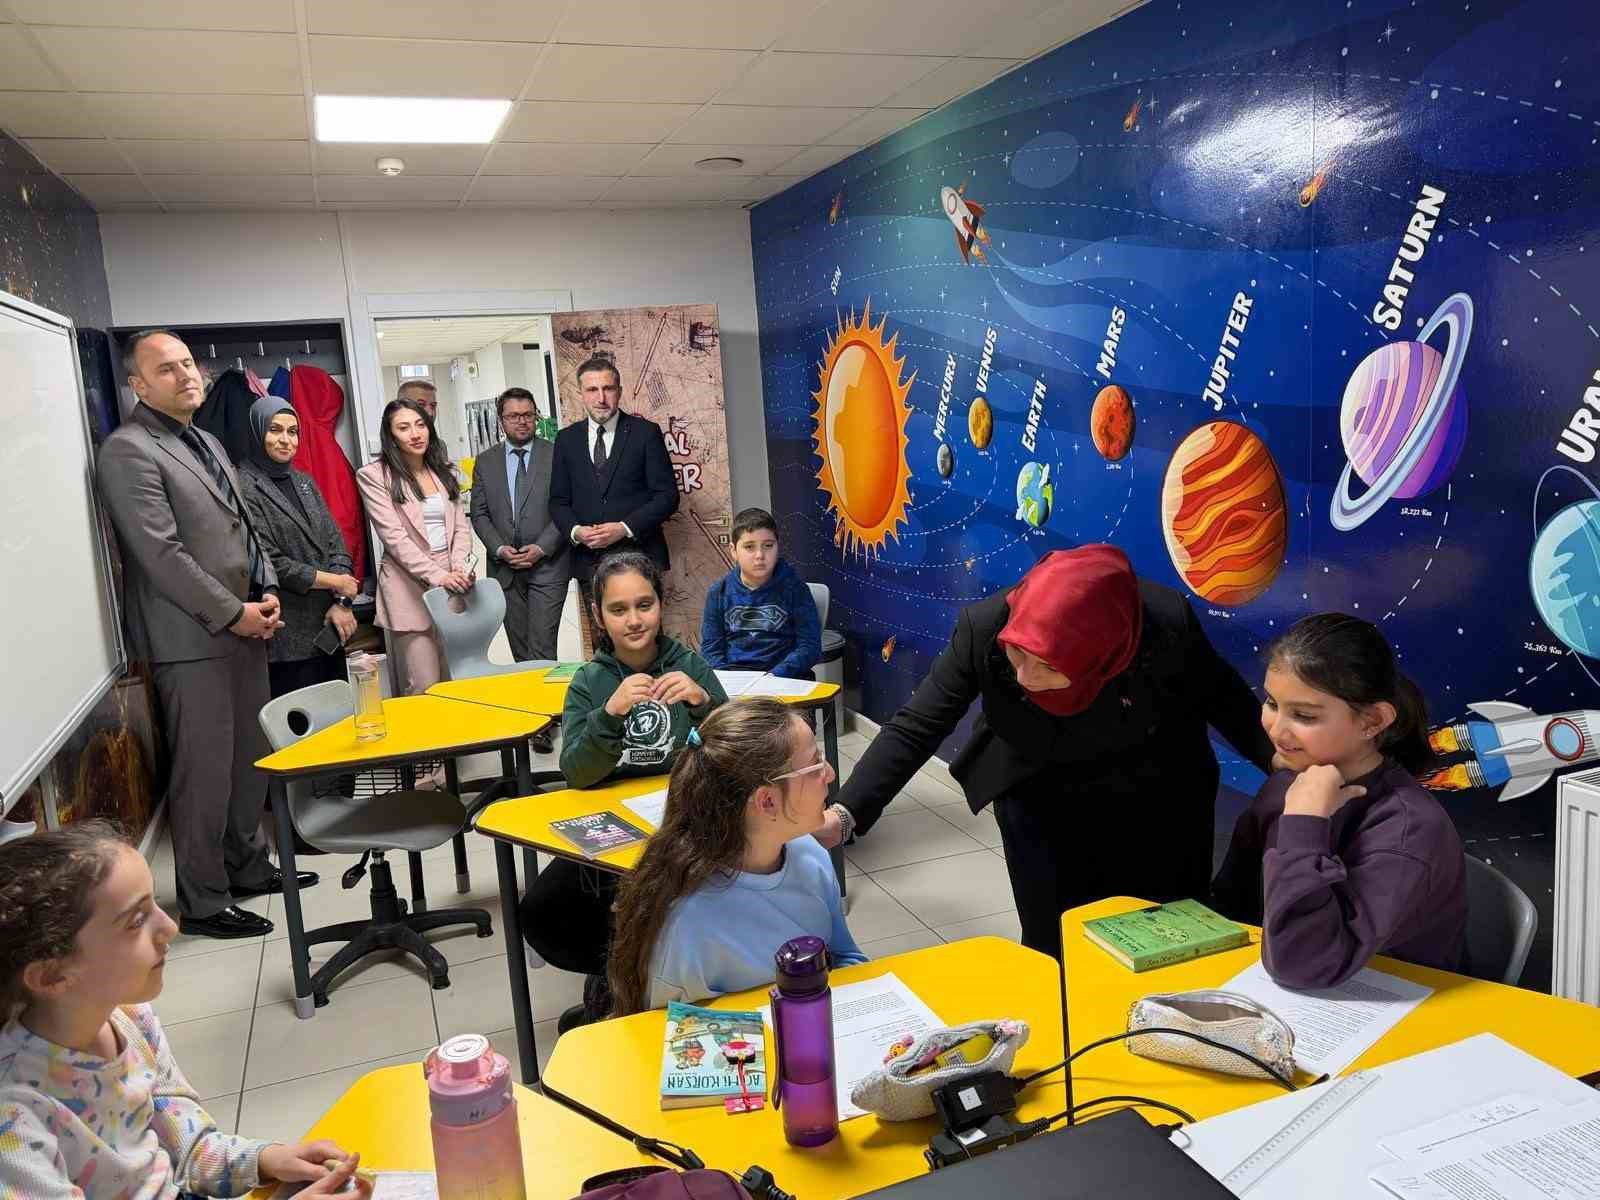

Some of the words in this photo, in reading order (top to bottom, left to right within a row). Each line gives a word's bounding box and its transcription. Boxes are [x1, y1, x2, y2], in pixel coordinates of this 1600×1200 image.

[830, 265, 842, 296] SUN
[1373, 184, 1448, 331] SATURN
[975, 326, 998, 393] VENUS
[1095, 306, 1127, 378] MARS
[1202, 291, 1254, 411] JUPITER
[933, 353, 956, 441] MERCURY
[1021, 379, 1048, 453] EARTH
[1556, 369, 1600, 463] URA
[667, 1074, 721, 1090] KORSAN
